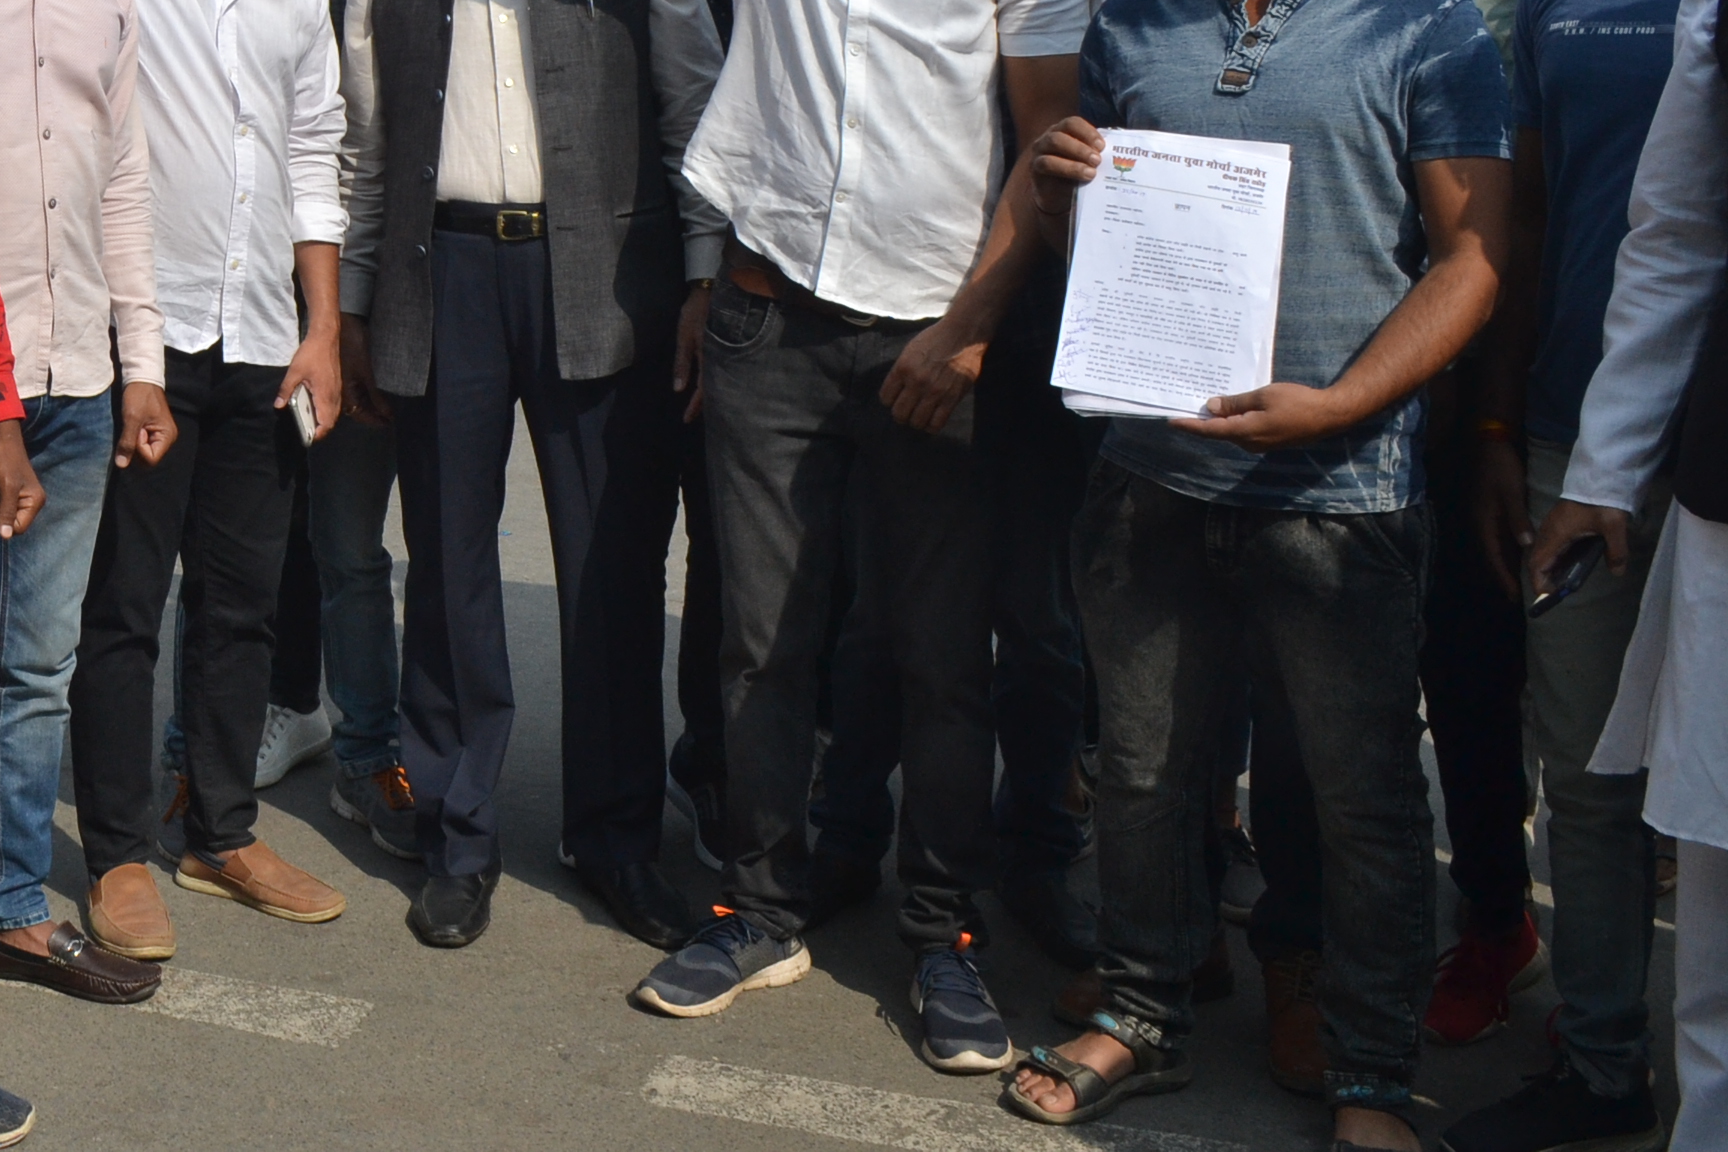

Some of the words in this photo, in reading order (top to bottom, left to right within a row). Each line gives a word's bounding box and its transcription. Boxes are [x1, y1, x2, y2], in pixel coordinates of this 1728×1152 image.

[1565, 19, 1580, 28] EAST
[1112, 145, 1150, 158] भारतीय
[1151, 151, 1181, 163] जनता
[1184, 156, 1204, 168] युवा
[1206, 158, 1231, 172] मोर्चा
[1233, 165, 1268, 179] अजमेर
